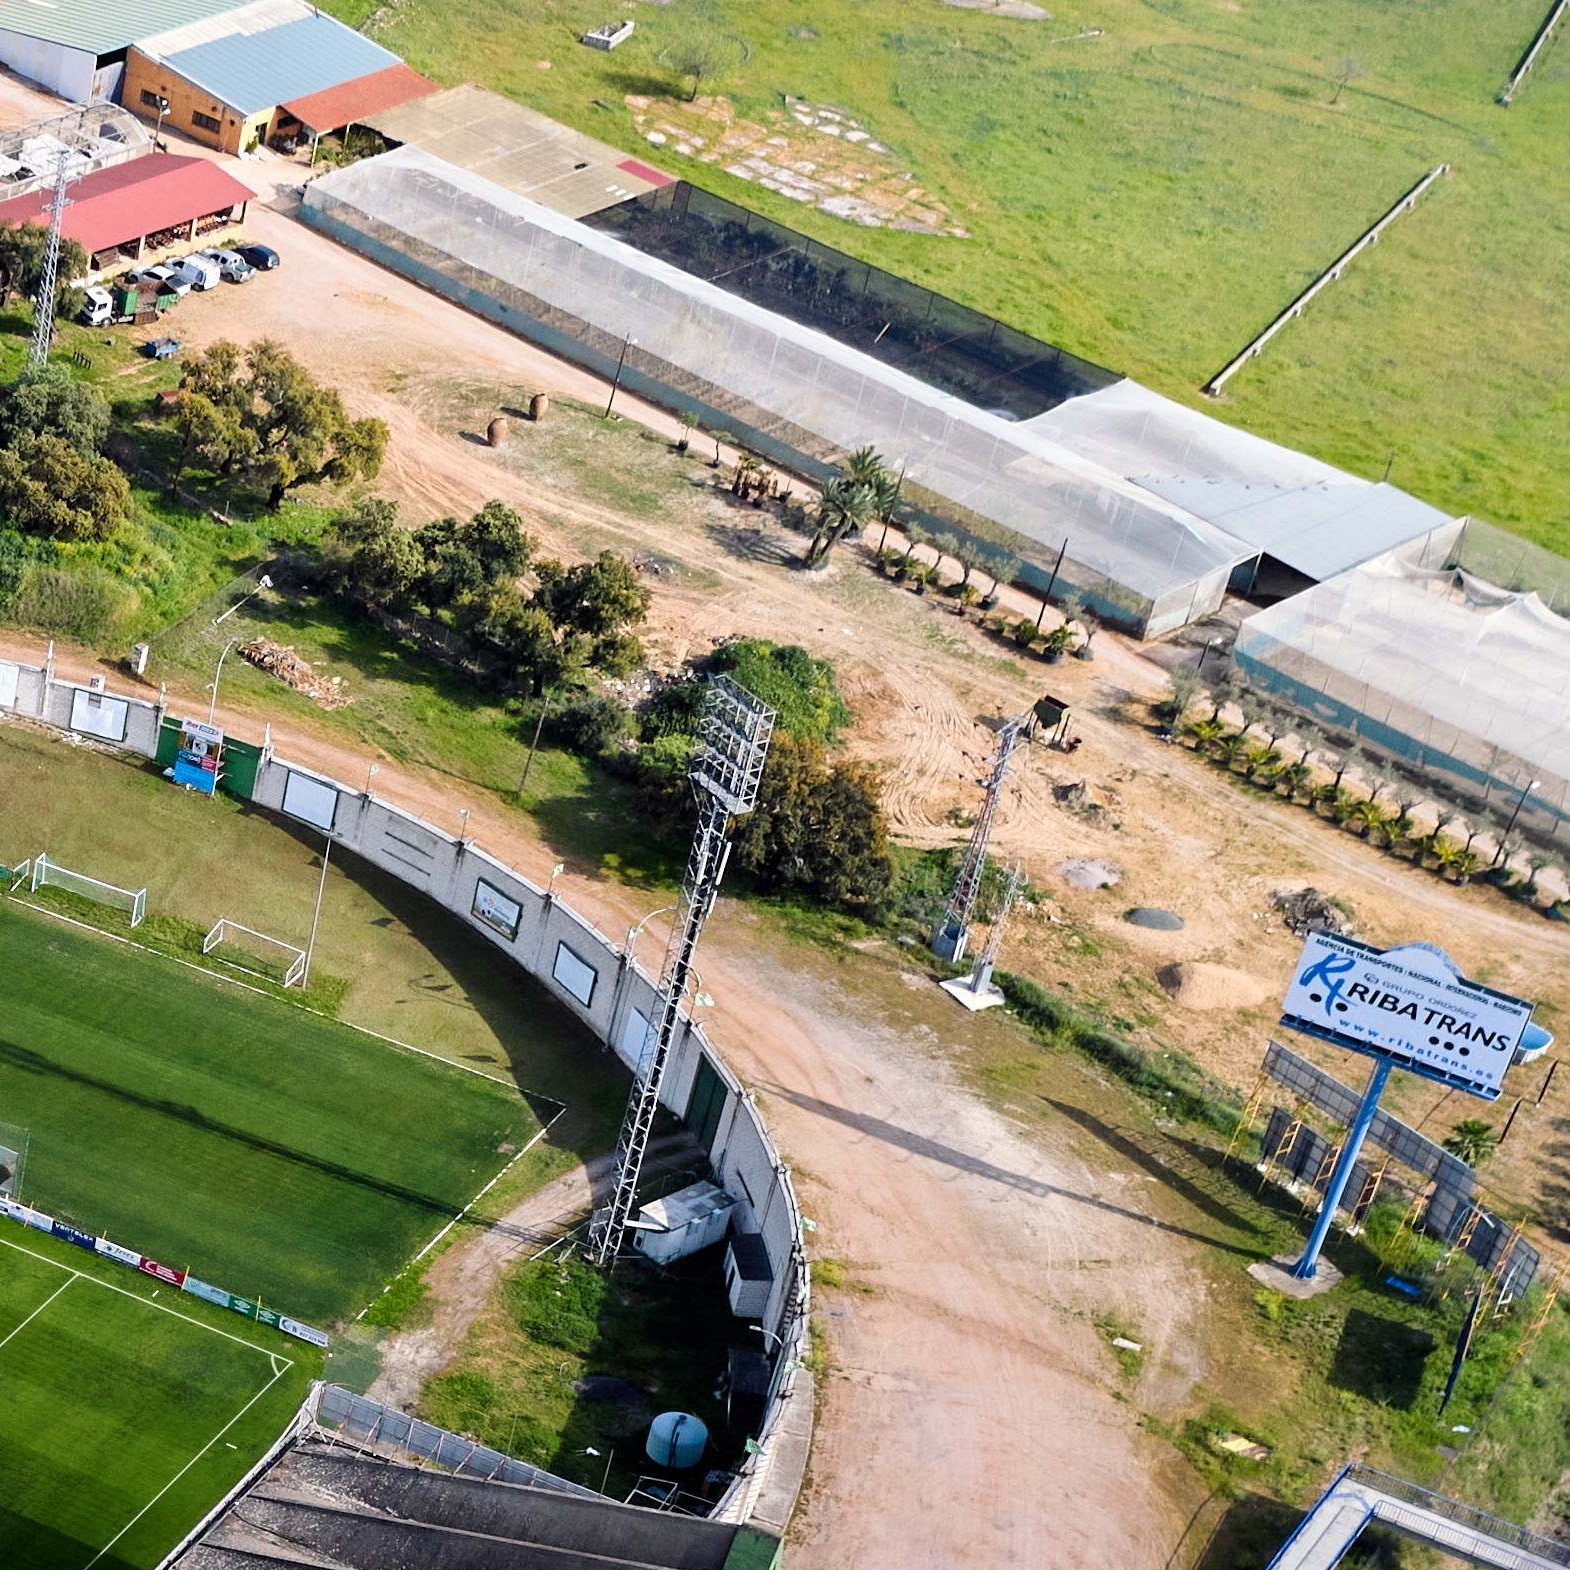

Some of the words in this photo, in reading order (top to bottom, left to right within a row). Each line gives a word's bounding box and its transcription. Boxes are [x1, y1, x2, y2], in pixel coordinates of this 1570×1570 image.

[1347, 982, 1511, 1052] RIBATRANS
[1382, 981, 1425, 1000] GRUPO
[1339, 1019, 1493, 1079] www.ribatrans.es
